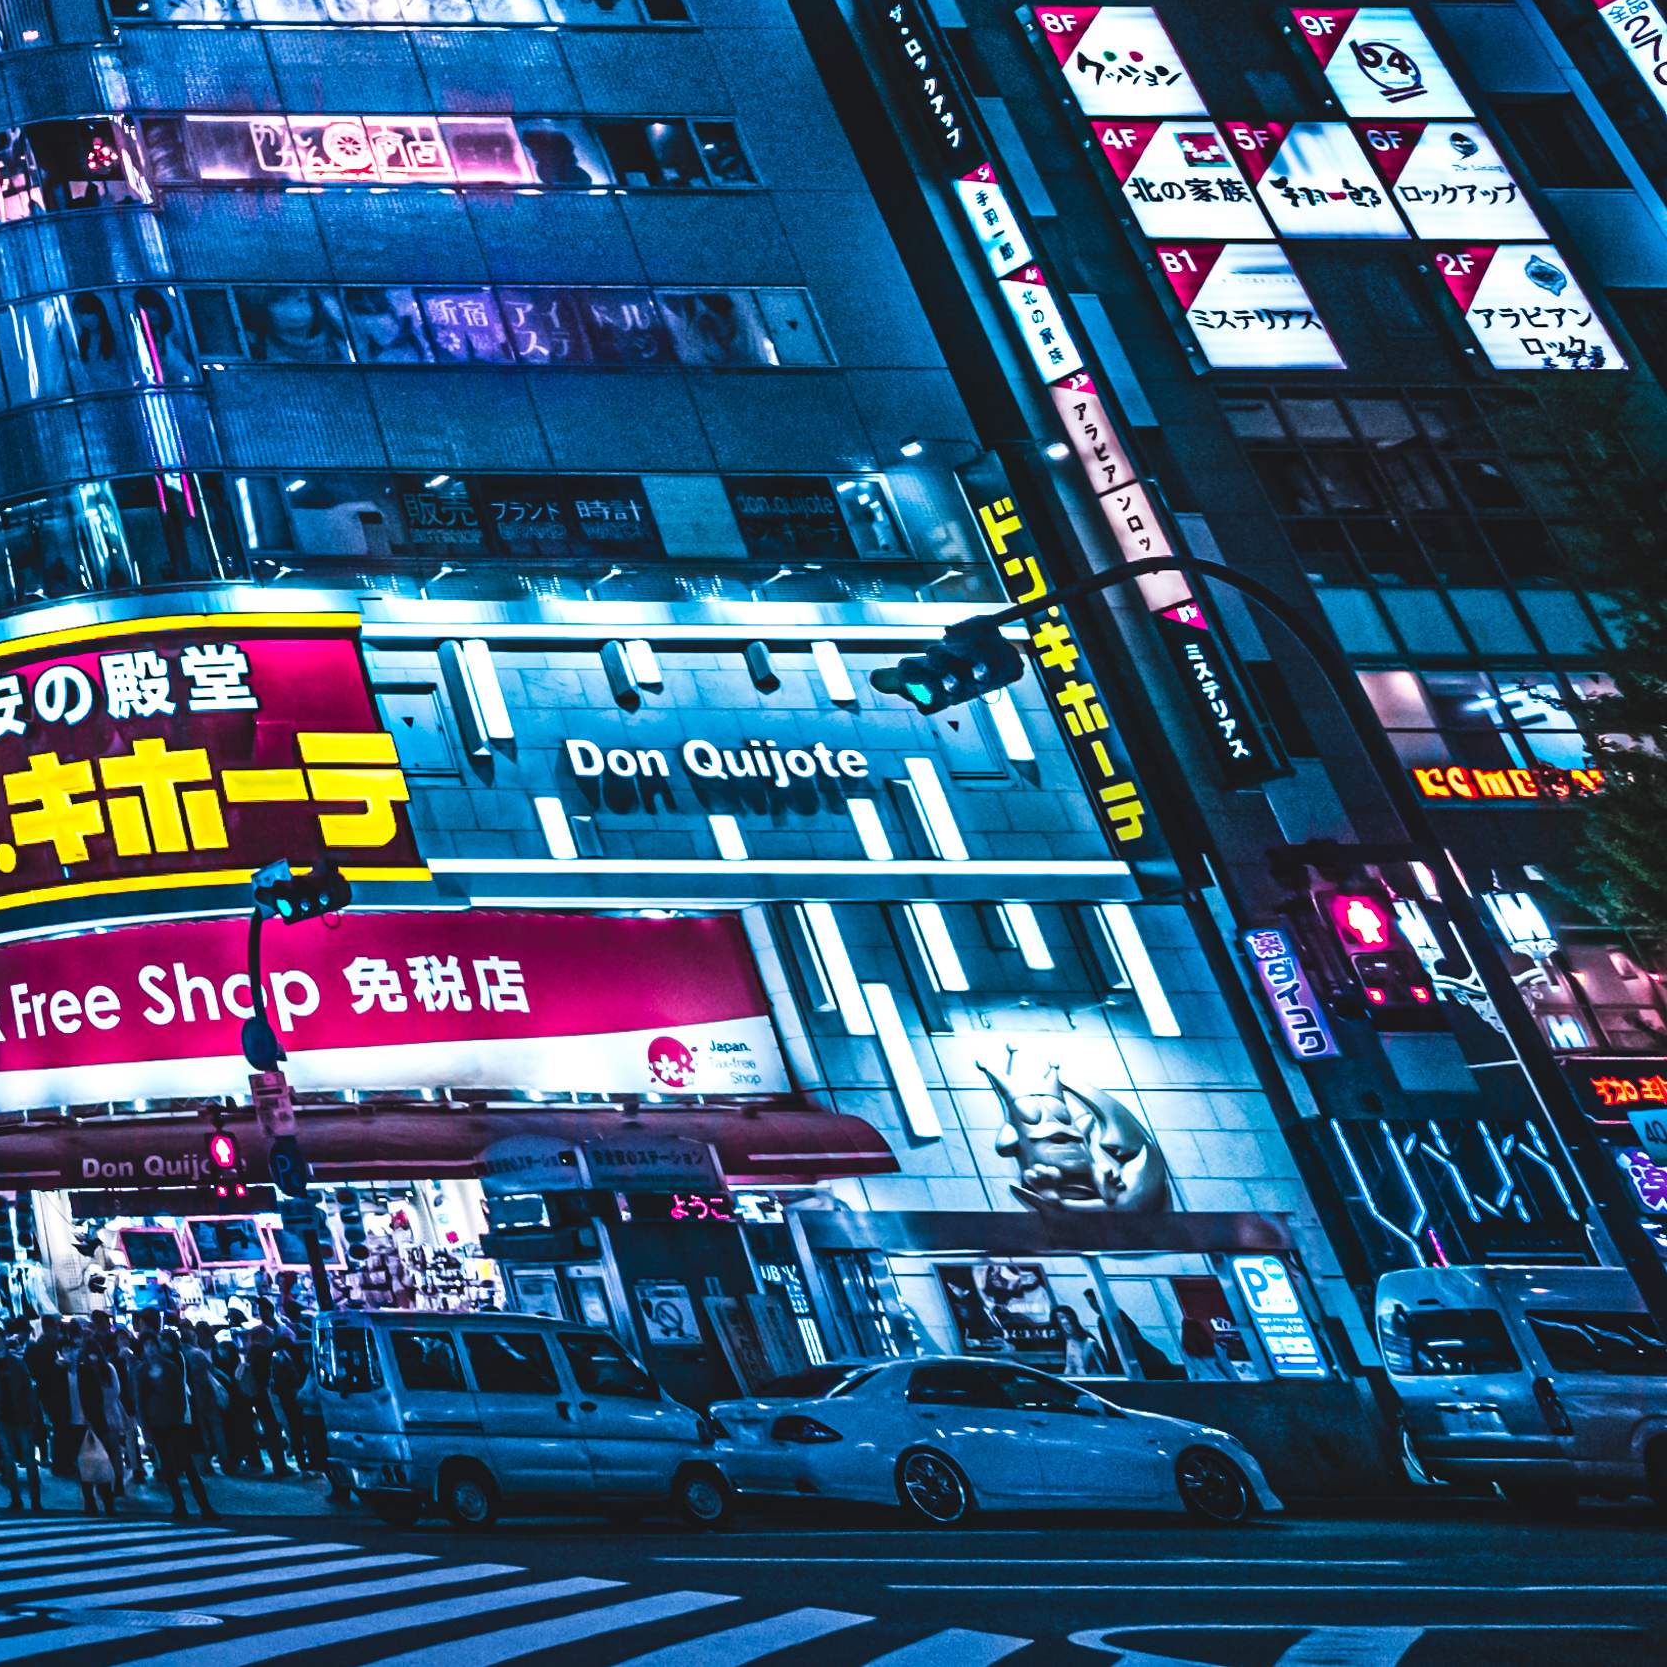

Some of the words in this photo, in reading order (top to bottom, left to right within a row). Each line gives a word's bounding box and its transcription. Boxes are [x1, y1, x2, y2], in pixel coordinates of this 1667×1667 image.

[1041, 13, 1077, 36] 8F
[1299, 14, 1336, 36] 9F
[1102, 127, 1139, 151] 4F
[1234, 128, 1270, 151] 5F
[1366, 128, 1405, 151] 6F
[1128, 177, 1254, 206] 北の家族
[1398, 182, 1519, 205] ロックアップ
[1159, 249, 1197, 274] B1
[1436, 253, 1475, 277] 2F
[1020, 290, 1067, 366] 北の家族
[1193, 310, 1324, 332] ミステリアス
[1471, 307, 1593, 329] アラビアン
[1520, 335, 1589, 358] ロック
[405, 492, 478, 532] 販売
[488, 498, 563, 524] ブランド
[574, 493, 645, 526] 時計
[1182, 643, 1252, 761] ミステリアス
[563, 736, 669, 775] Don
[680, 735, 868, 786] Quijote
[9, 982, 121, 1038] Free
[143, 963, 321, 1032] Shop
[343, 956, 532, 1017] 免税店
[82, 1155, 133, 1181] Don
[1243, 1263, 1269, 1311] P
